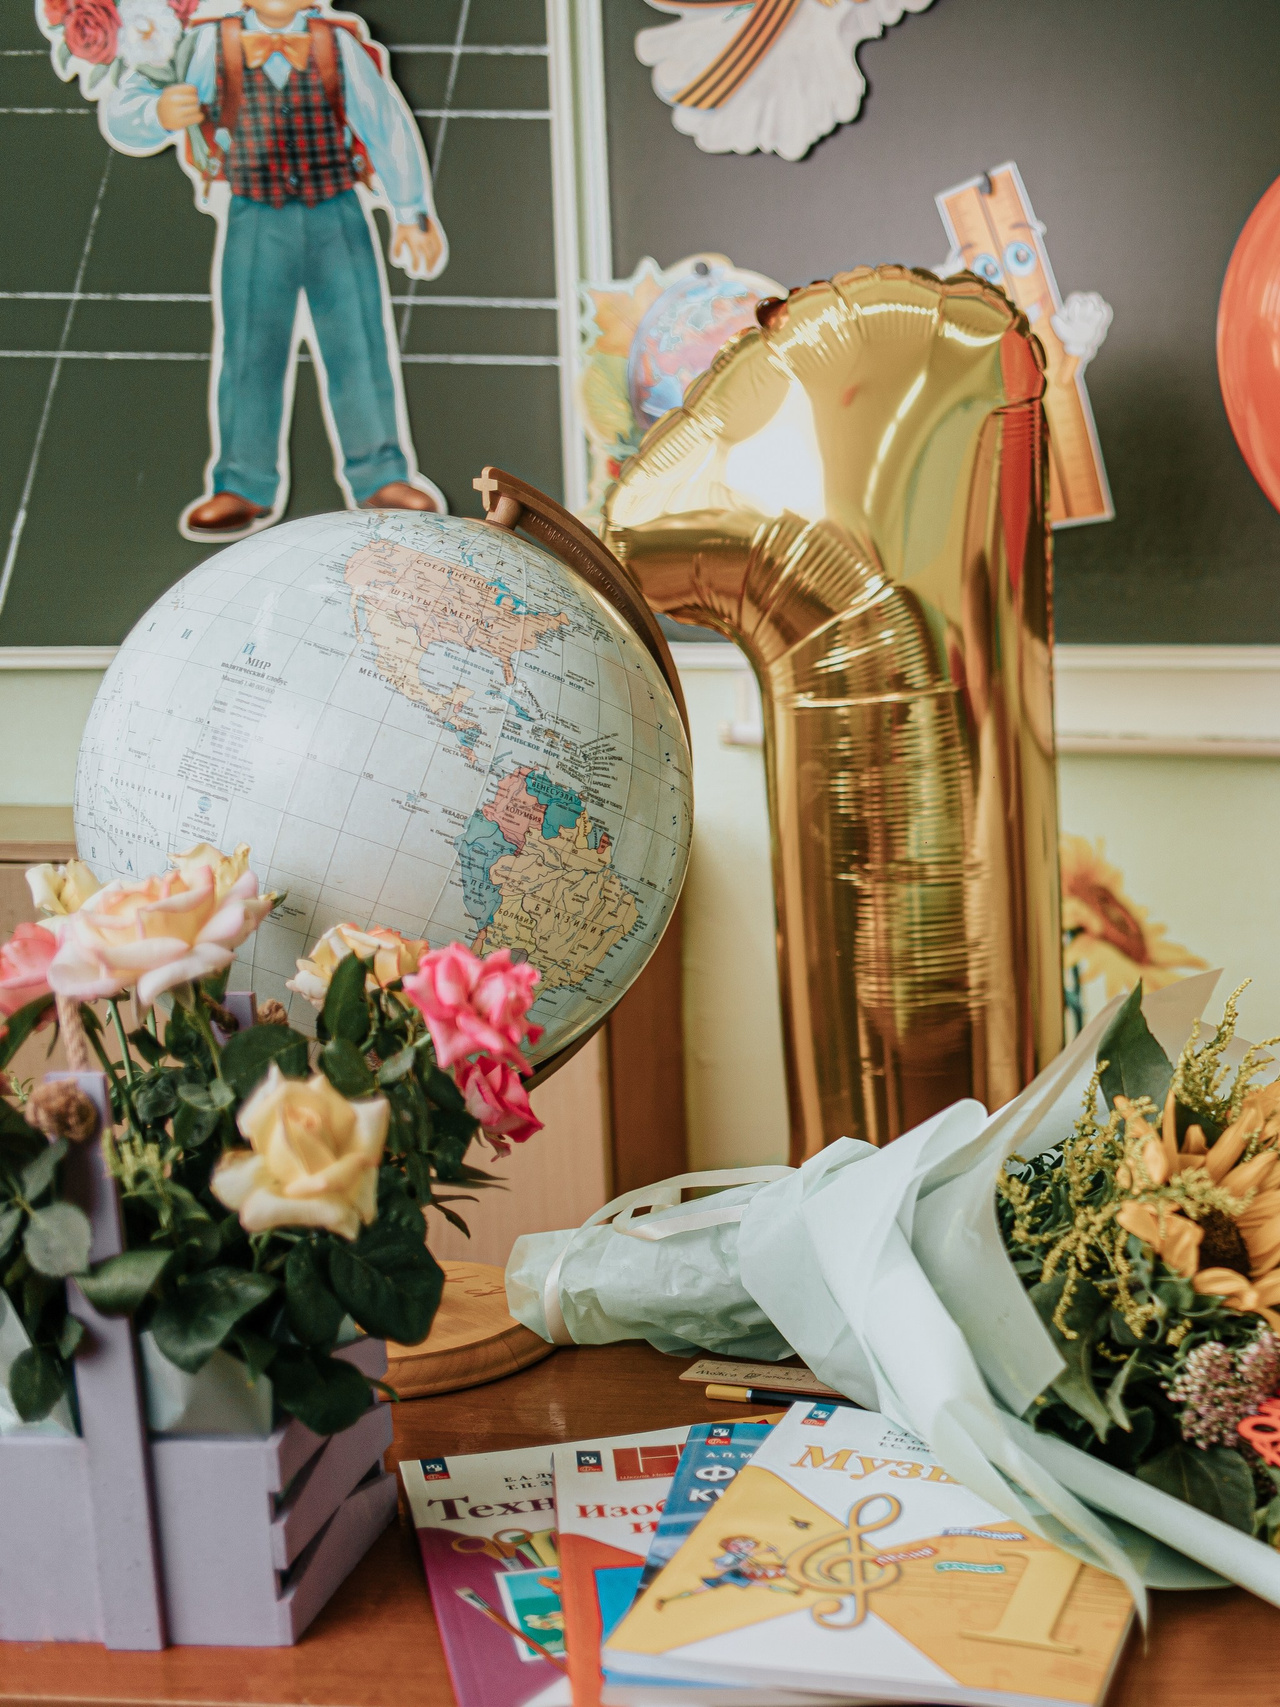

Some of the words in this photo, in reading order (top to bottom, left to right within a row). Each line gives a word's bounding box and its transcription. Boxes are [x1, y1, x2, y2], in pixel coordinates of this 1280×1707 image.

[391, 588, 432, 606] ШТАТЫ
[441, 606, 495, 630] АМЕРИКИ
[245, 656, 272, 670] МИР
[444, 651, 495, 675] Мексиканский
[452, 665, 471, 676] залив
[221, 662, 266, 680] политический
[266, 672, 288, 686] глобус
[222, 674, 244, 686] Масштаб
[358, 667, 405, 689] МЕКСИКА
[524, 662, 565, 683] САРГАССОВО
[568, 681, 586, 692] МОРЕ
[543, 749, 561, 760] МОРЕ
[362, 771, 374, 780] 100
[532, 782, 574, 802] ВЕНЕСУЭЛА
[441, 808, 468, 820] ЭКВАДОР
[505, 805, 543, 824] КОЛУМБИЯ
[470, 879, 498, 893] ПЕРУ
[498, 908, 534, 925] БОЛИВИЯ
[534, 903, 606, 937] БРАЗИЛИЯ
[959, 1548, 1083, 1655] 1
